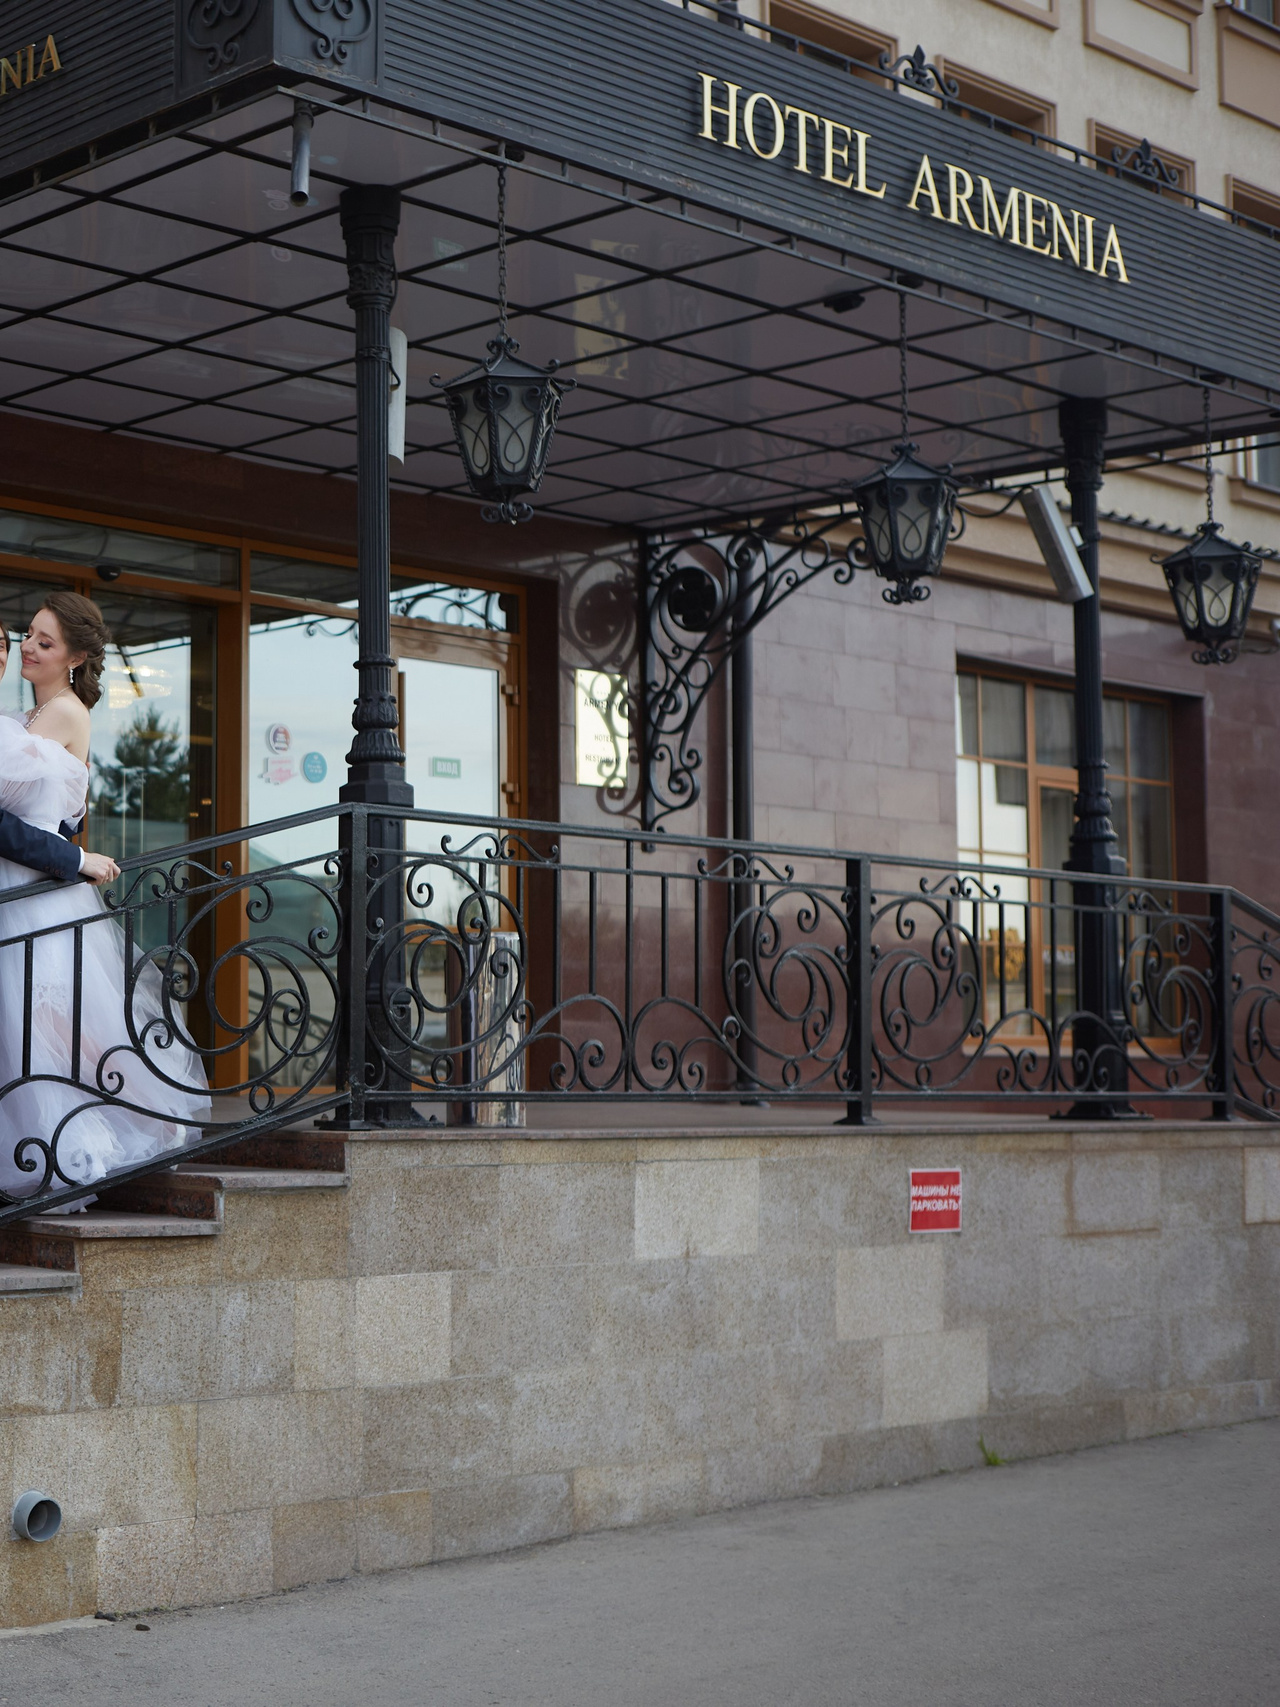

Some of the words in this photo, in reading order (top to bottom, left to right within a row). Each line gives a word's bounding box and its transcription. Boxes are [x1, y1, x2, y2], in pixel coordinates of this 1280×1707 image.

[697, 72, 887, 199] HOTEL
[907, 153, 1130, 283] ARMENIA
[437, 761, 458, 775] ВХОД
[911, 1184, 949, 1197] МАШИНЫ
